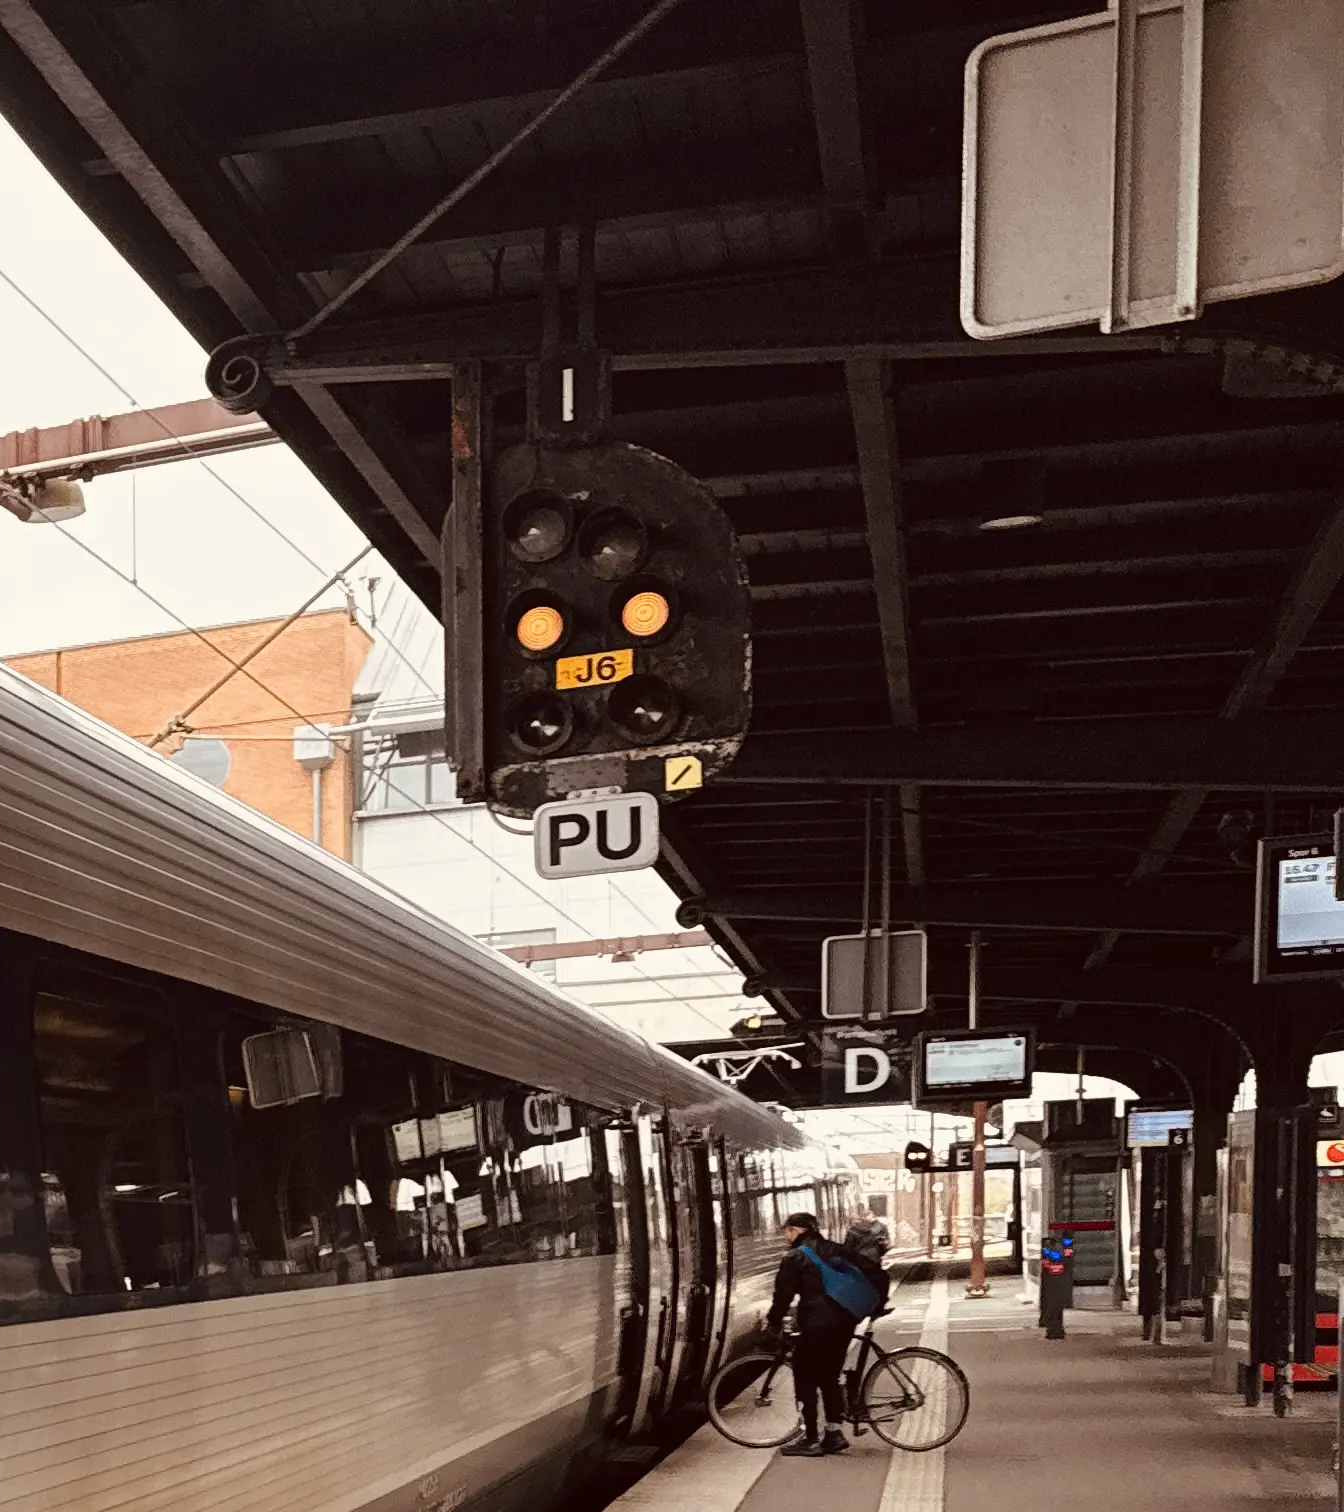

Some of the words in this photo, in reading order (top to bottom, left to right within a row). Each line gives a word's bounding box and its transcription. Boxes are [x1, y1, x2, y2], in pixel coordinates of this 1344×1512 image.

[575, 655, 617, 683] J6
[548, 805, 642, 867] PU
[844, 1047, 892, 1095] D
[955, 1148, 973, 1167] E
